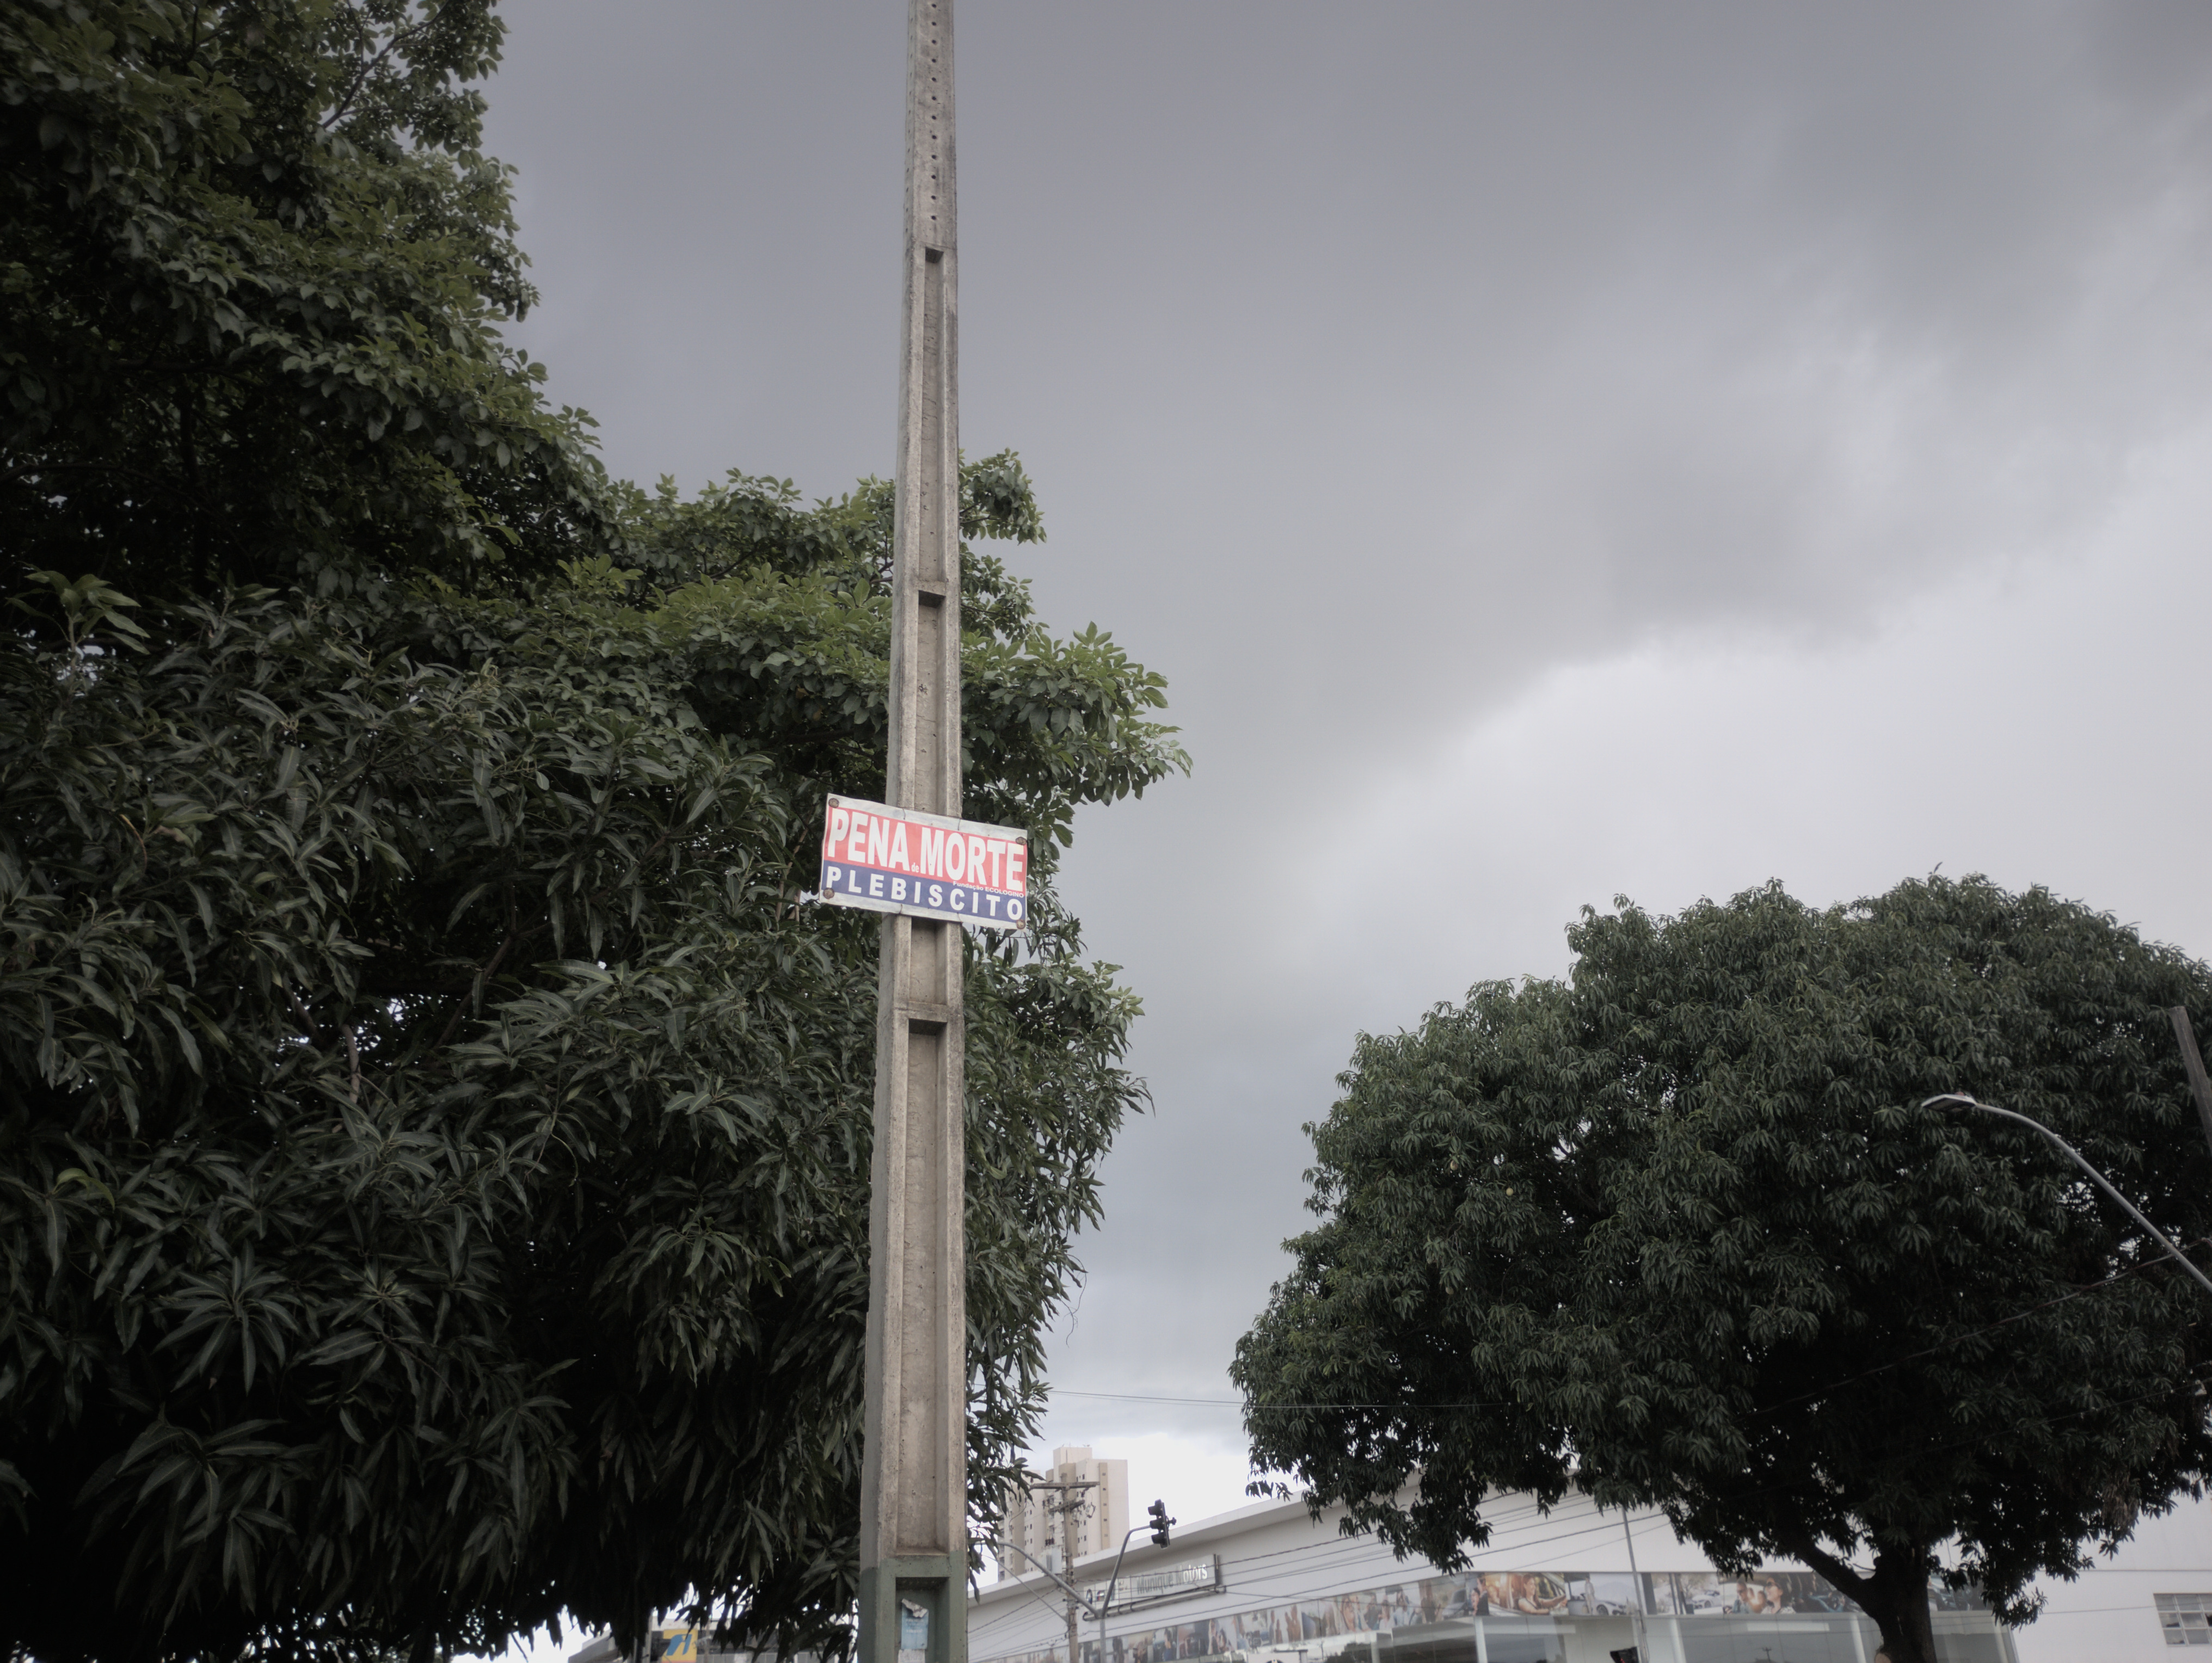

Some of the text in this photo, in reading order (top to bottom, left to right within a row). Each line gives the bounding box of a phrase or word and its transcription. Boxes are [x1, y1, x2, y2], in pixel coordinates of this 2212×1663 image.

[828, 808, 1024, 892] PENA de MORTE
[826, 866, 1023, 920] PLEBISCITO
[1137, 1564, 1208, 1594] Munique Motors
